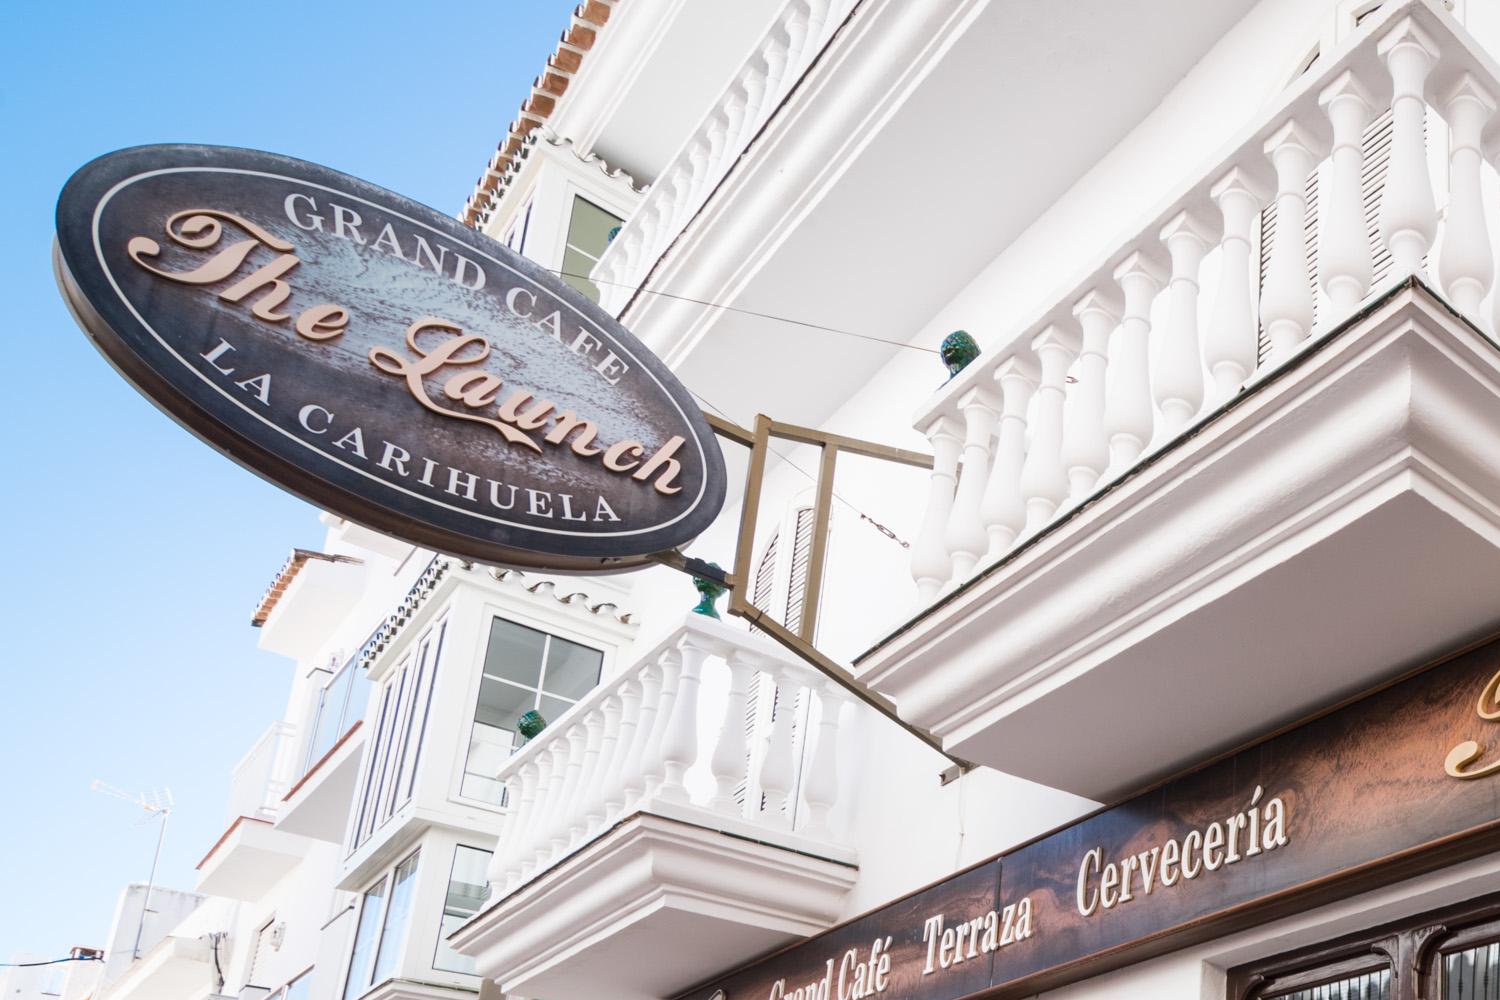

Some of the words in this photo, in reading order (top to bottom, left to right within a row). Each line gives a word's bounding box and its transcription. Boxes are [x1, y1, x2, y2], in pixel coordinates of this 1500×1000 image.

[128, 208, 350, 341] The
[369, 317, 684, 496] Launch
[283, 193, 487, 292] GRAND
[505, 284, 628, 385] CAFE
[200, 337, 272, 406] LA
[299, 403, 622, 525] CARIHUELA
[922, 897, 1032, 976] Terraza
[1076, 785, 1287, 916] Cervecería
